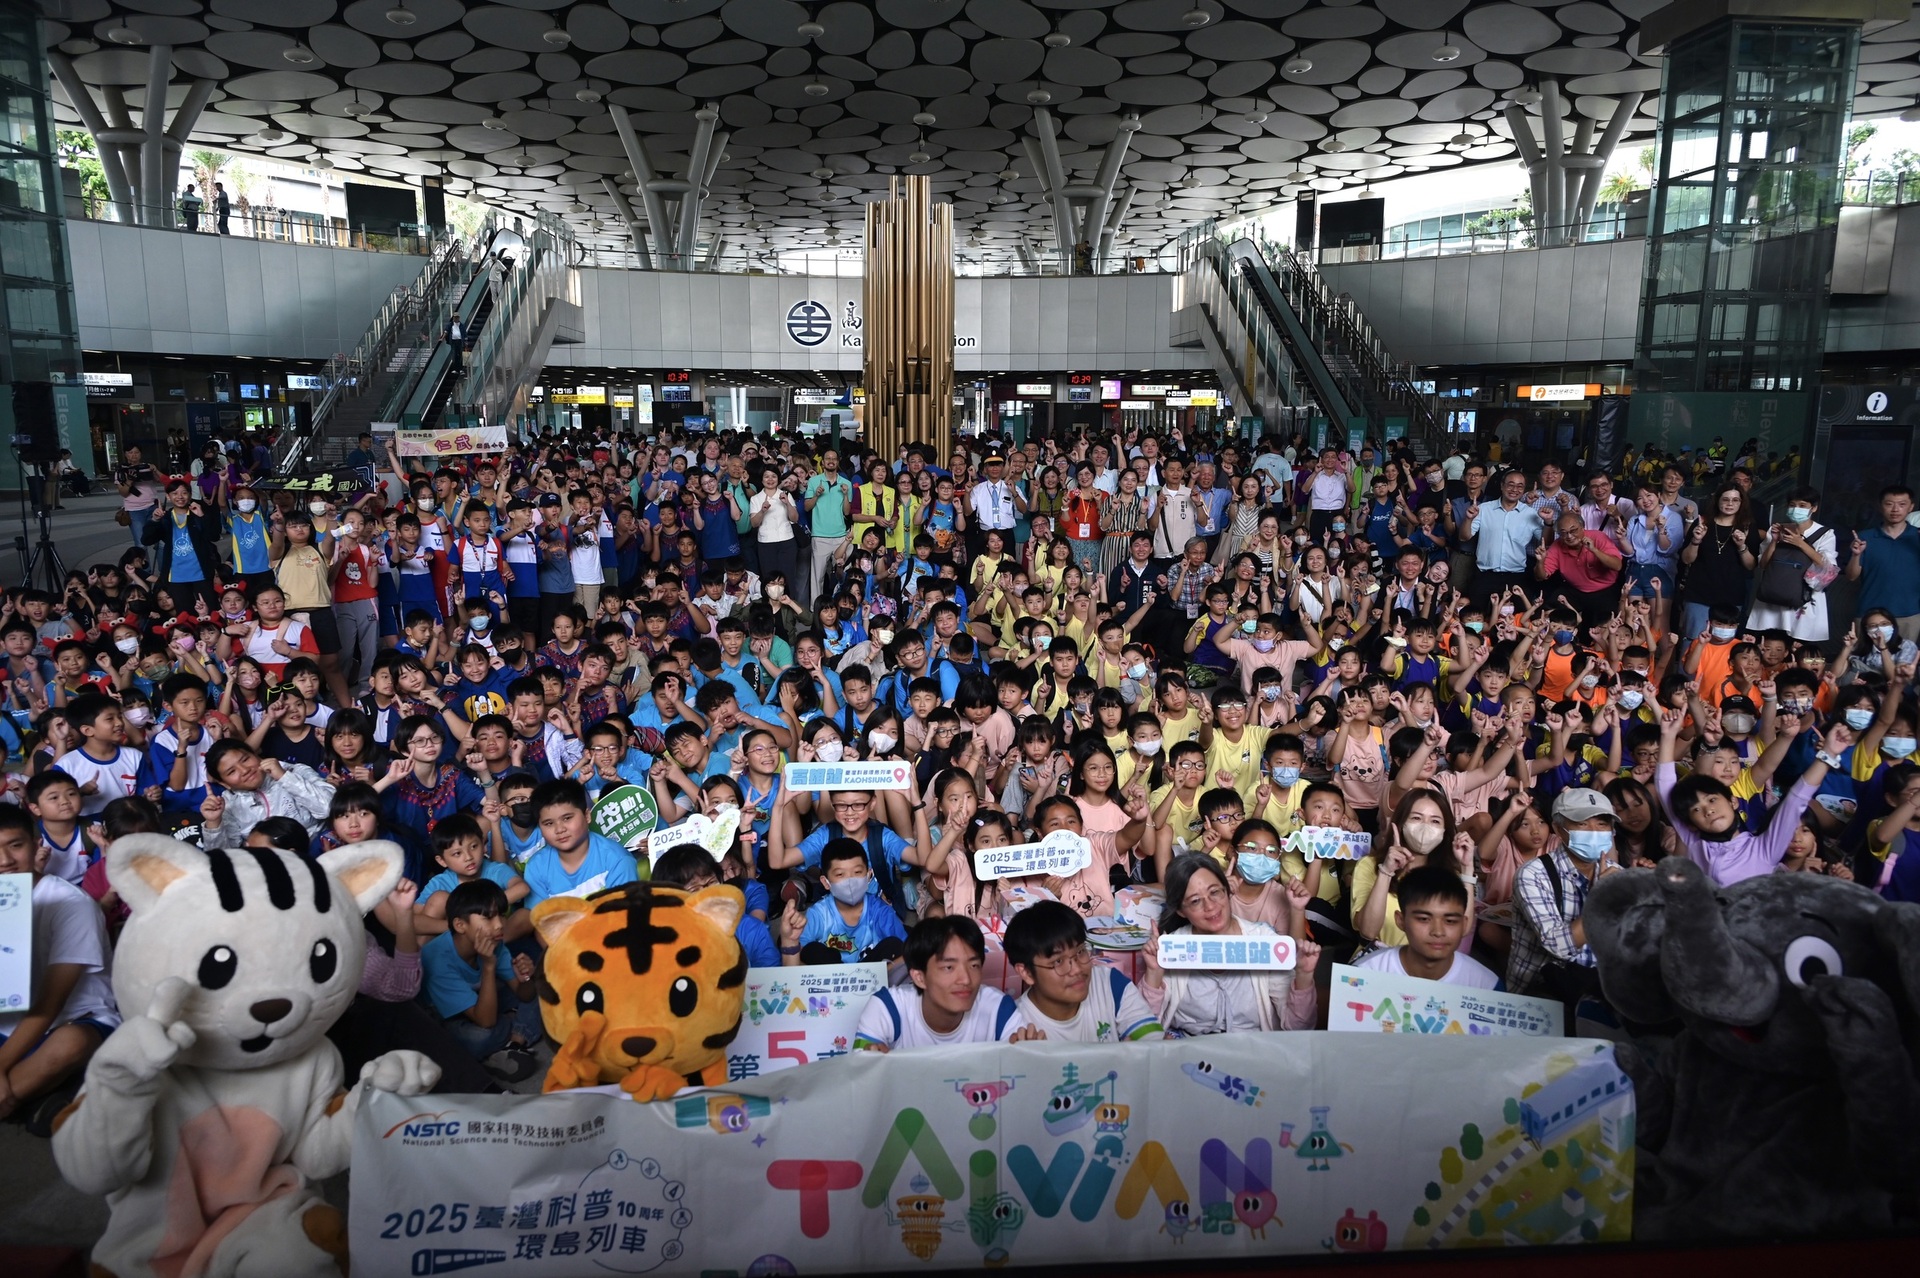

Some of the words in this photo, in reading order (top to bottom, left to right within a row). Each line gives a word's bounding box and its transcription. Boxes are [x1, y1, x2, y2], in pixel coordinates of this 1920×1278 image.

[842, 301, 862, 329] 高
[434, 434, 473, 452] 仁武
[282, 473, 334, 491] 仁武
[337, 480, 363, 491] 國小
[791, 768, 843, 785] 高雄站
[844, 776, 893, 784] KAOHSIUNG
[653, 829, 683, 847] 2025
[1343, 833, 1369, 844] 高雄站
[1025, 857, 1070, 871] 環島列車
[1161, 941, 1198, 953] 下一站
[1201, 941, 1271, 964] 高雄站
[833, 985, 867, 993] 環島列車
[1498, 1017, 1538, 1031] 環島列車
[403, 1121, 461, 1138] NSTC
[467, 1115, 605, 1139] 國家科學及技術委員會
[402, 1139, 445, 1147] National
[449, 1136, 487, 1145] Science
[513, 1138, 567, 1148] Technology
[570, 1127, 605, 1143] Council
[512, 1223, 648, 1260] 環島列車
